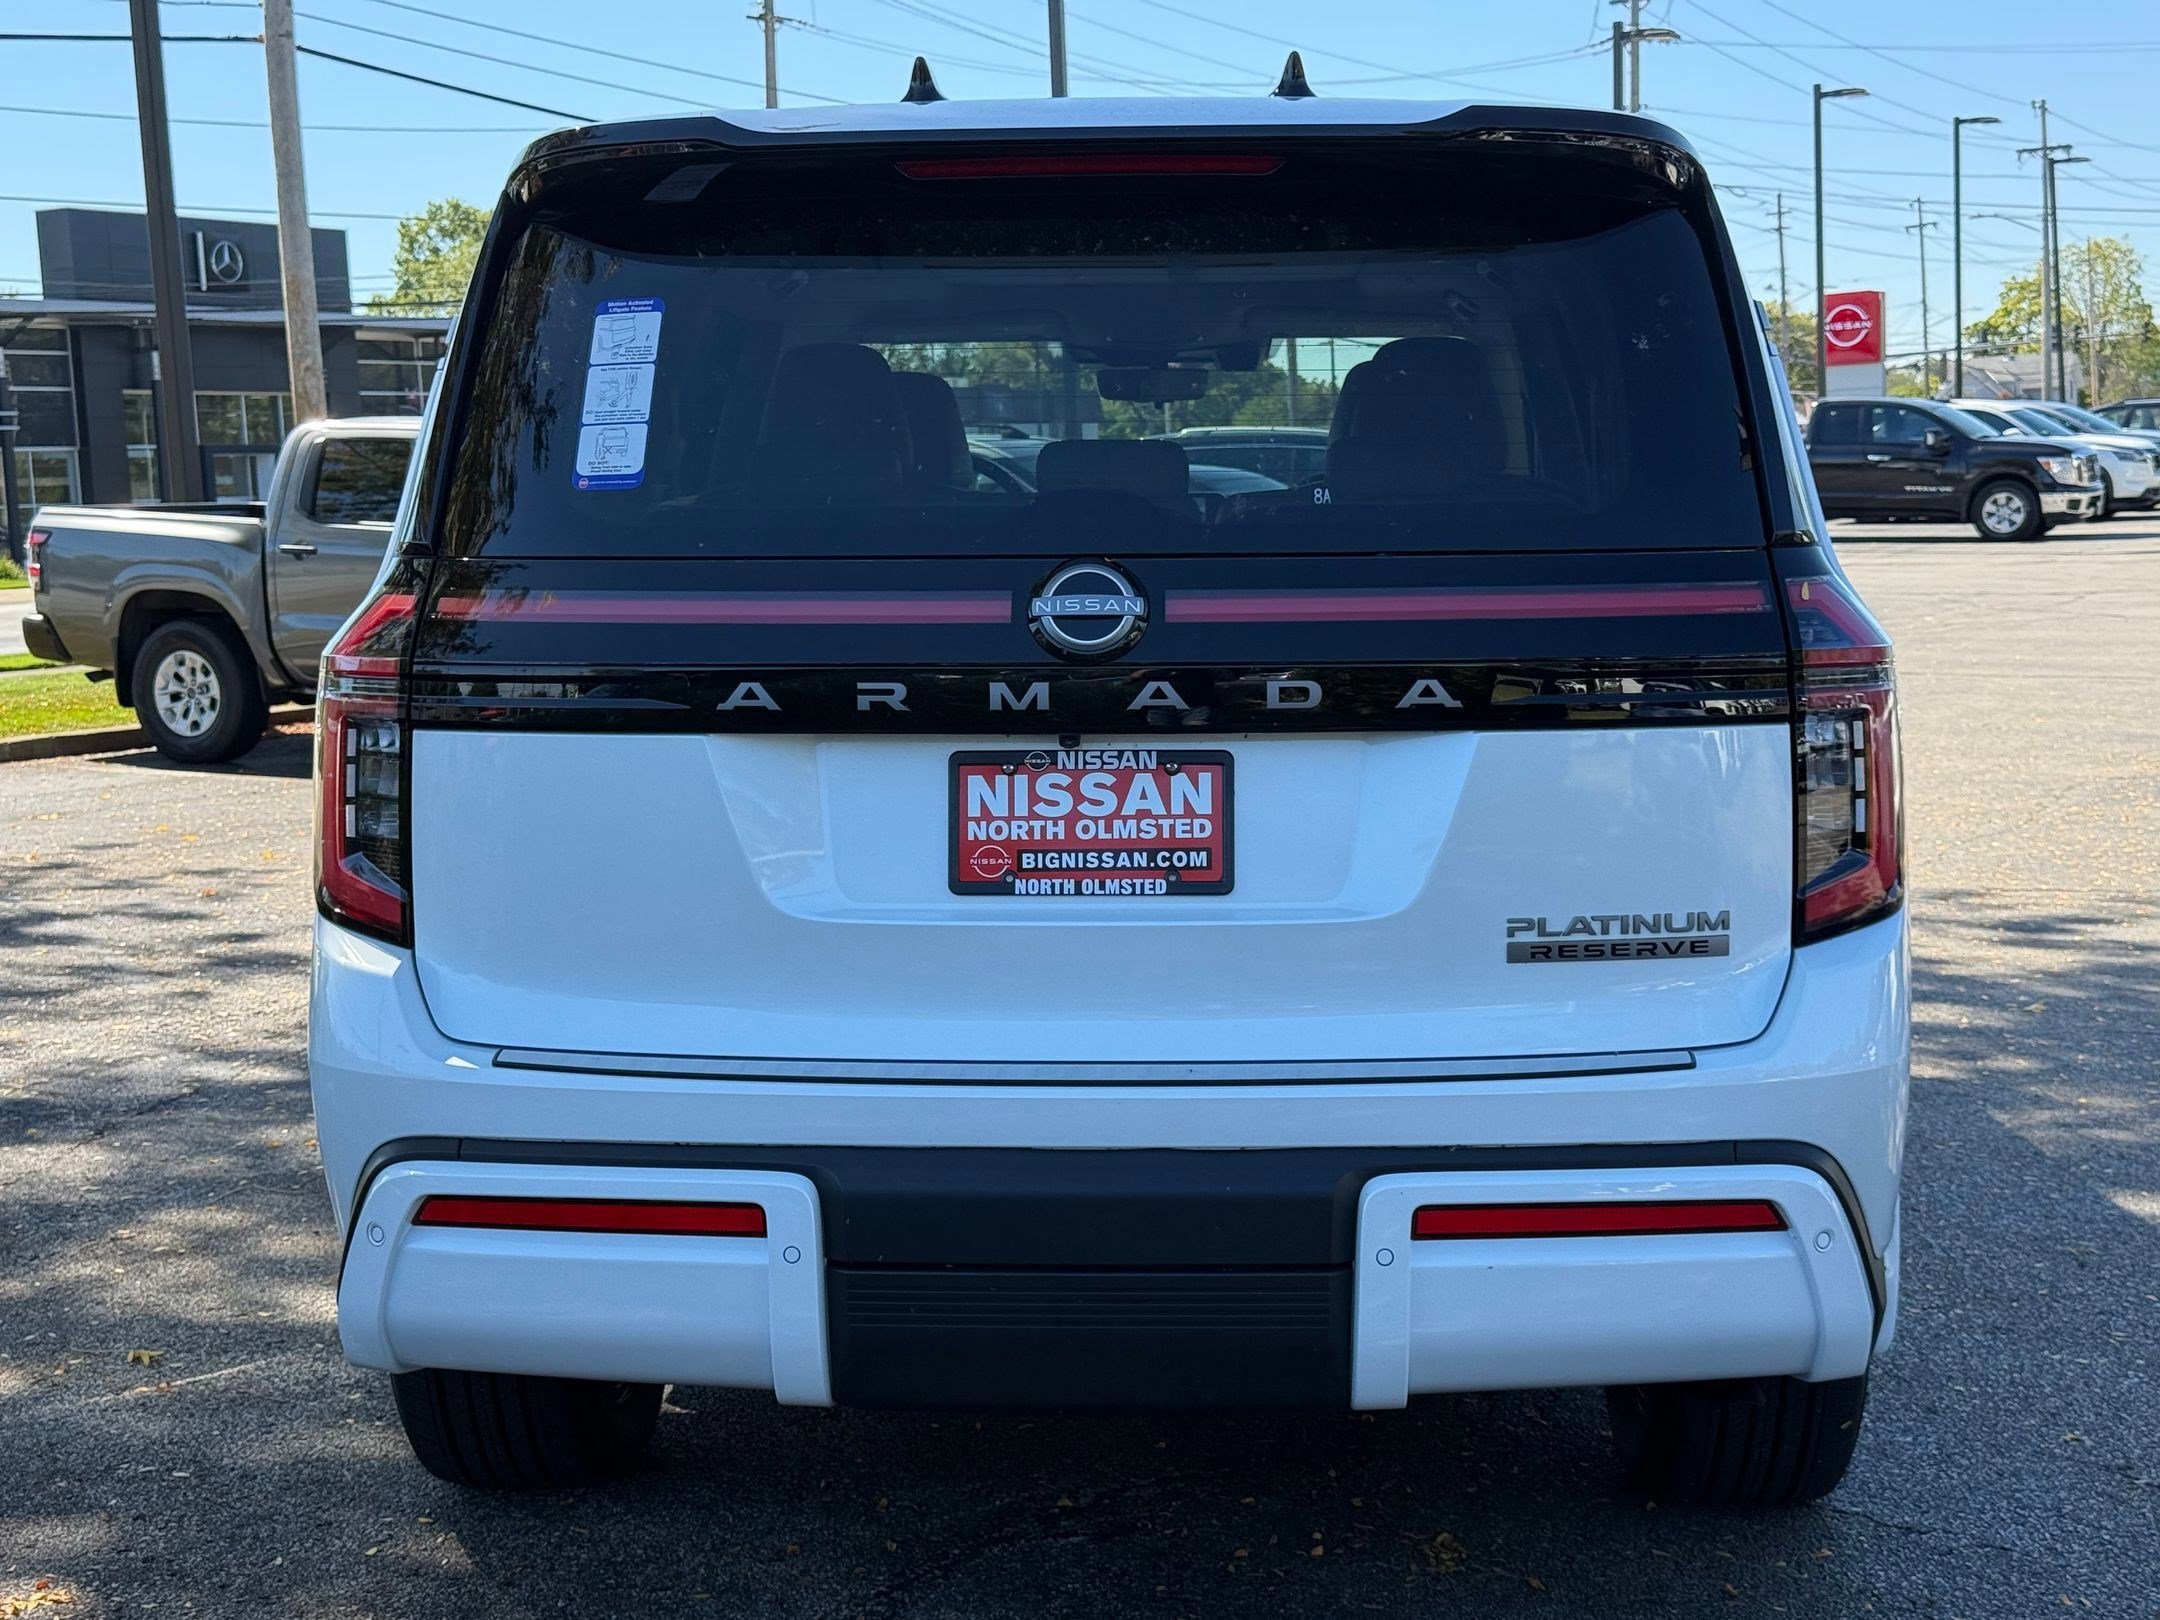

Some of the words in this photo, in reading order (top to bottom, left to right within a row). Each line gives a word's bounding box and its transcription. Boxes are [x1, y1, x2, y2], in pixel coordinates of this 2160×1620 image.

[1313, 487, 1332, 505] 8A
[1035, 598, 1142, 613] NISSAN
[716, 678, 1463, 712] ARMADA
[1057, 751, 1158, 770] NISSAN
[967, 772, 1213, 818] NISSAN
[967, 820, 1065, 841] NORTH
[1075, 818, 1213, 840] OLMSTED
[970, 857, 1012, 866] NISSAN
[1021, 851, 1208, 869] BIGNISSAN.COM
[1014, 879, 1075, 895] NORTH
[1081, 878, 1167, 895] OLMSTED
[1506, 910, 1731, 938] PLATINUM
[1529, 939, 1710, 960] RESERVE
